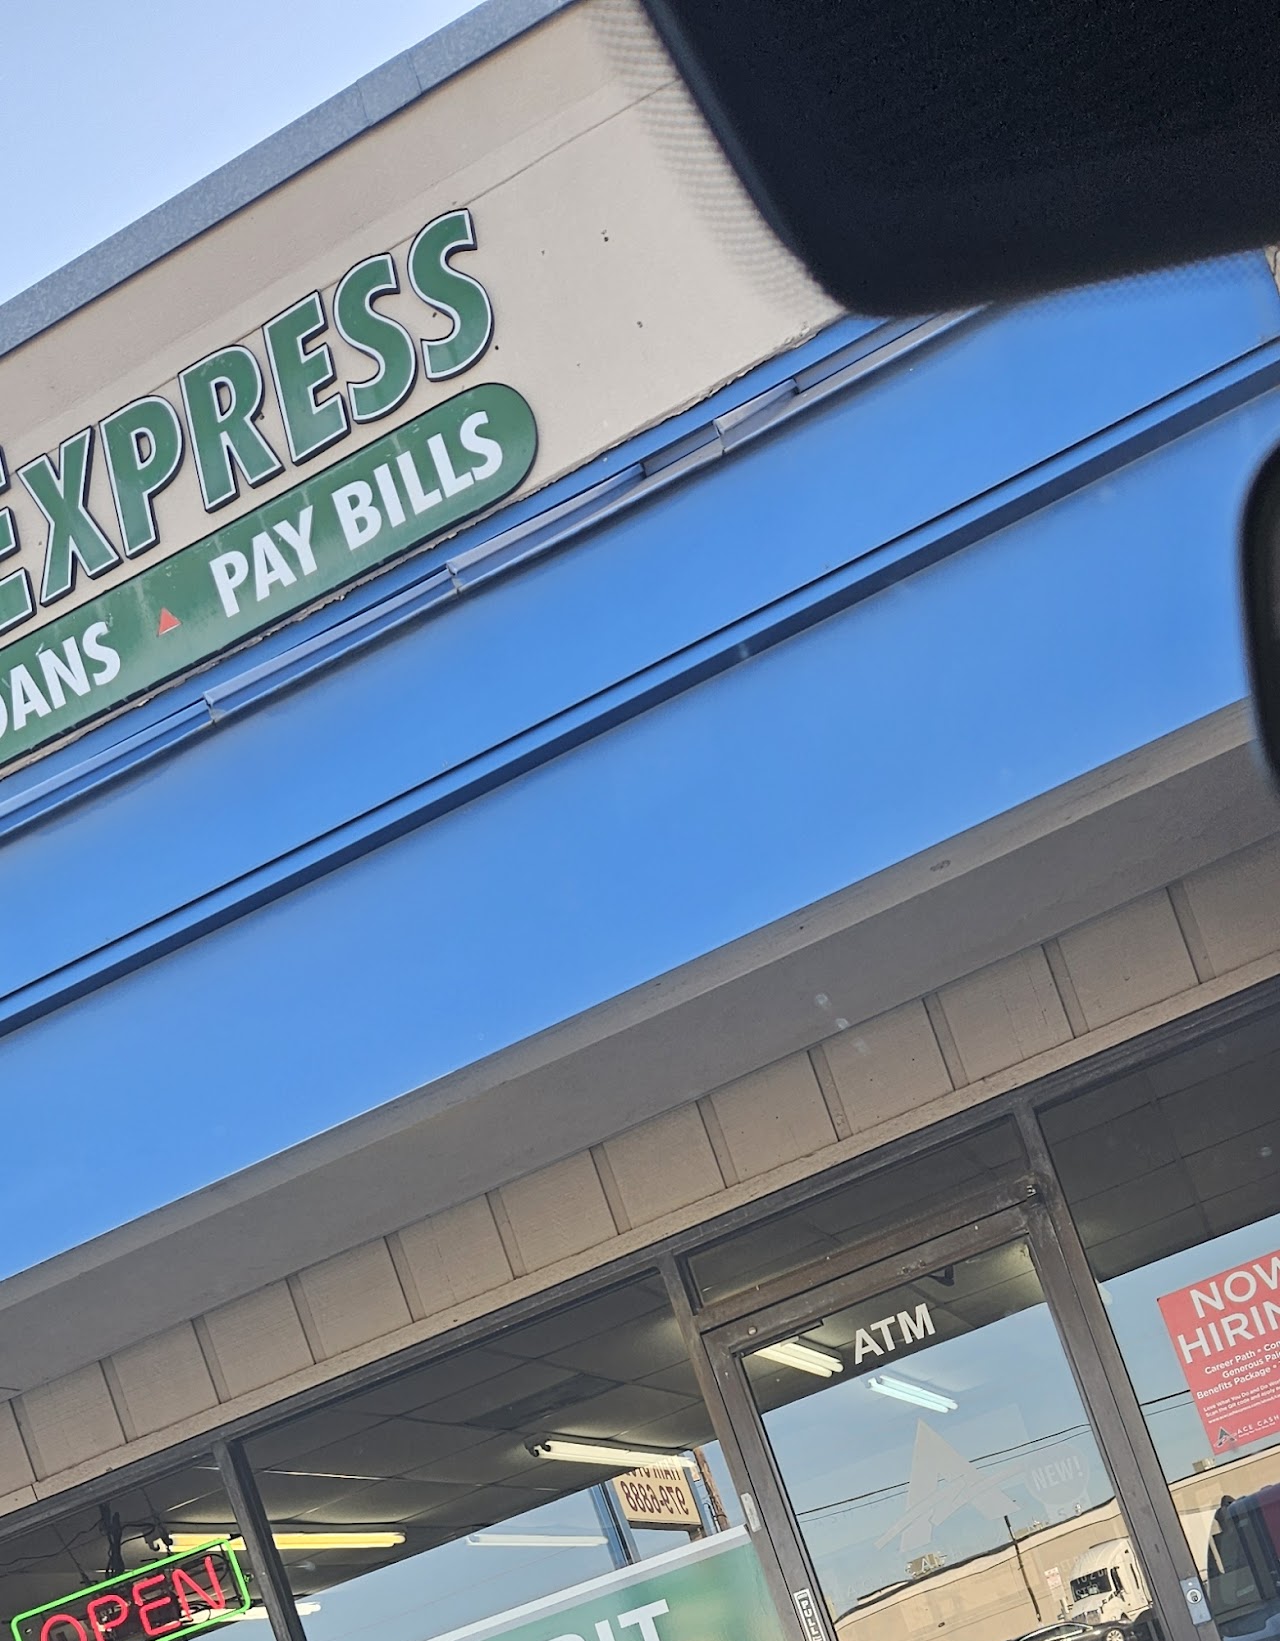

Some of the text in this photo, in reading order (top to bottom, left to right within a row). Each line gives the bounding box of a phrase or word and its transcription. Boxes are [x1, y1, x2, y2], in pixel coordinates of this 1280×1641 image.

[0, 410, 503, 740] ANS PAY BILLS
[1189, 1256, 1280, 1318] NOW
[853, 1302, 937, 1365] ATM
[1205, 1359, 1233, 1375] Career
[1235, 1350, 1256, 1363] Path
[1222, 1358, 1264, 1378] Generous
[1196, 1366, 1271, 1399] Benefits Package
[1237, 1424, 1253, 1434] ACE
[1257, 1415, 1279, 1427] CASH
[1031, 1456, 1083, 1491] NEW!
